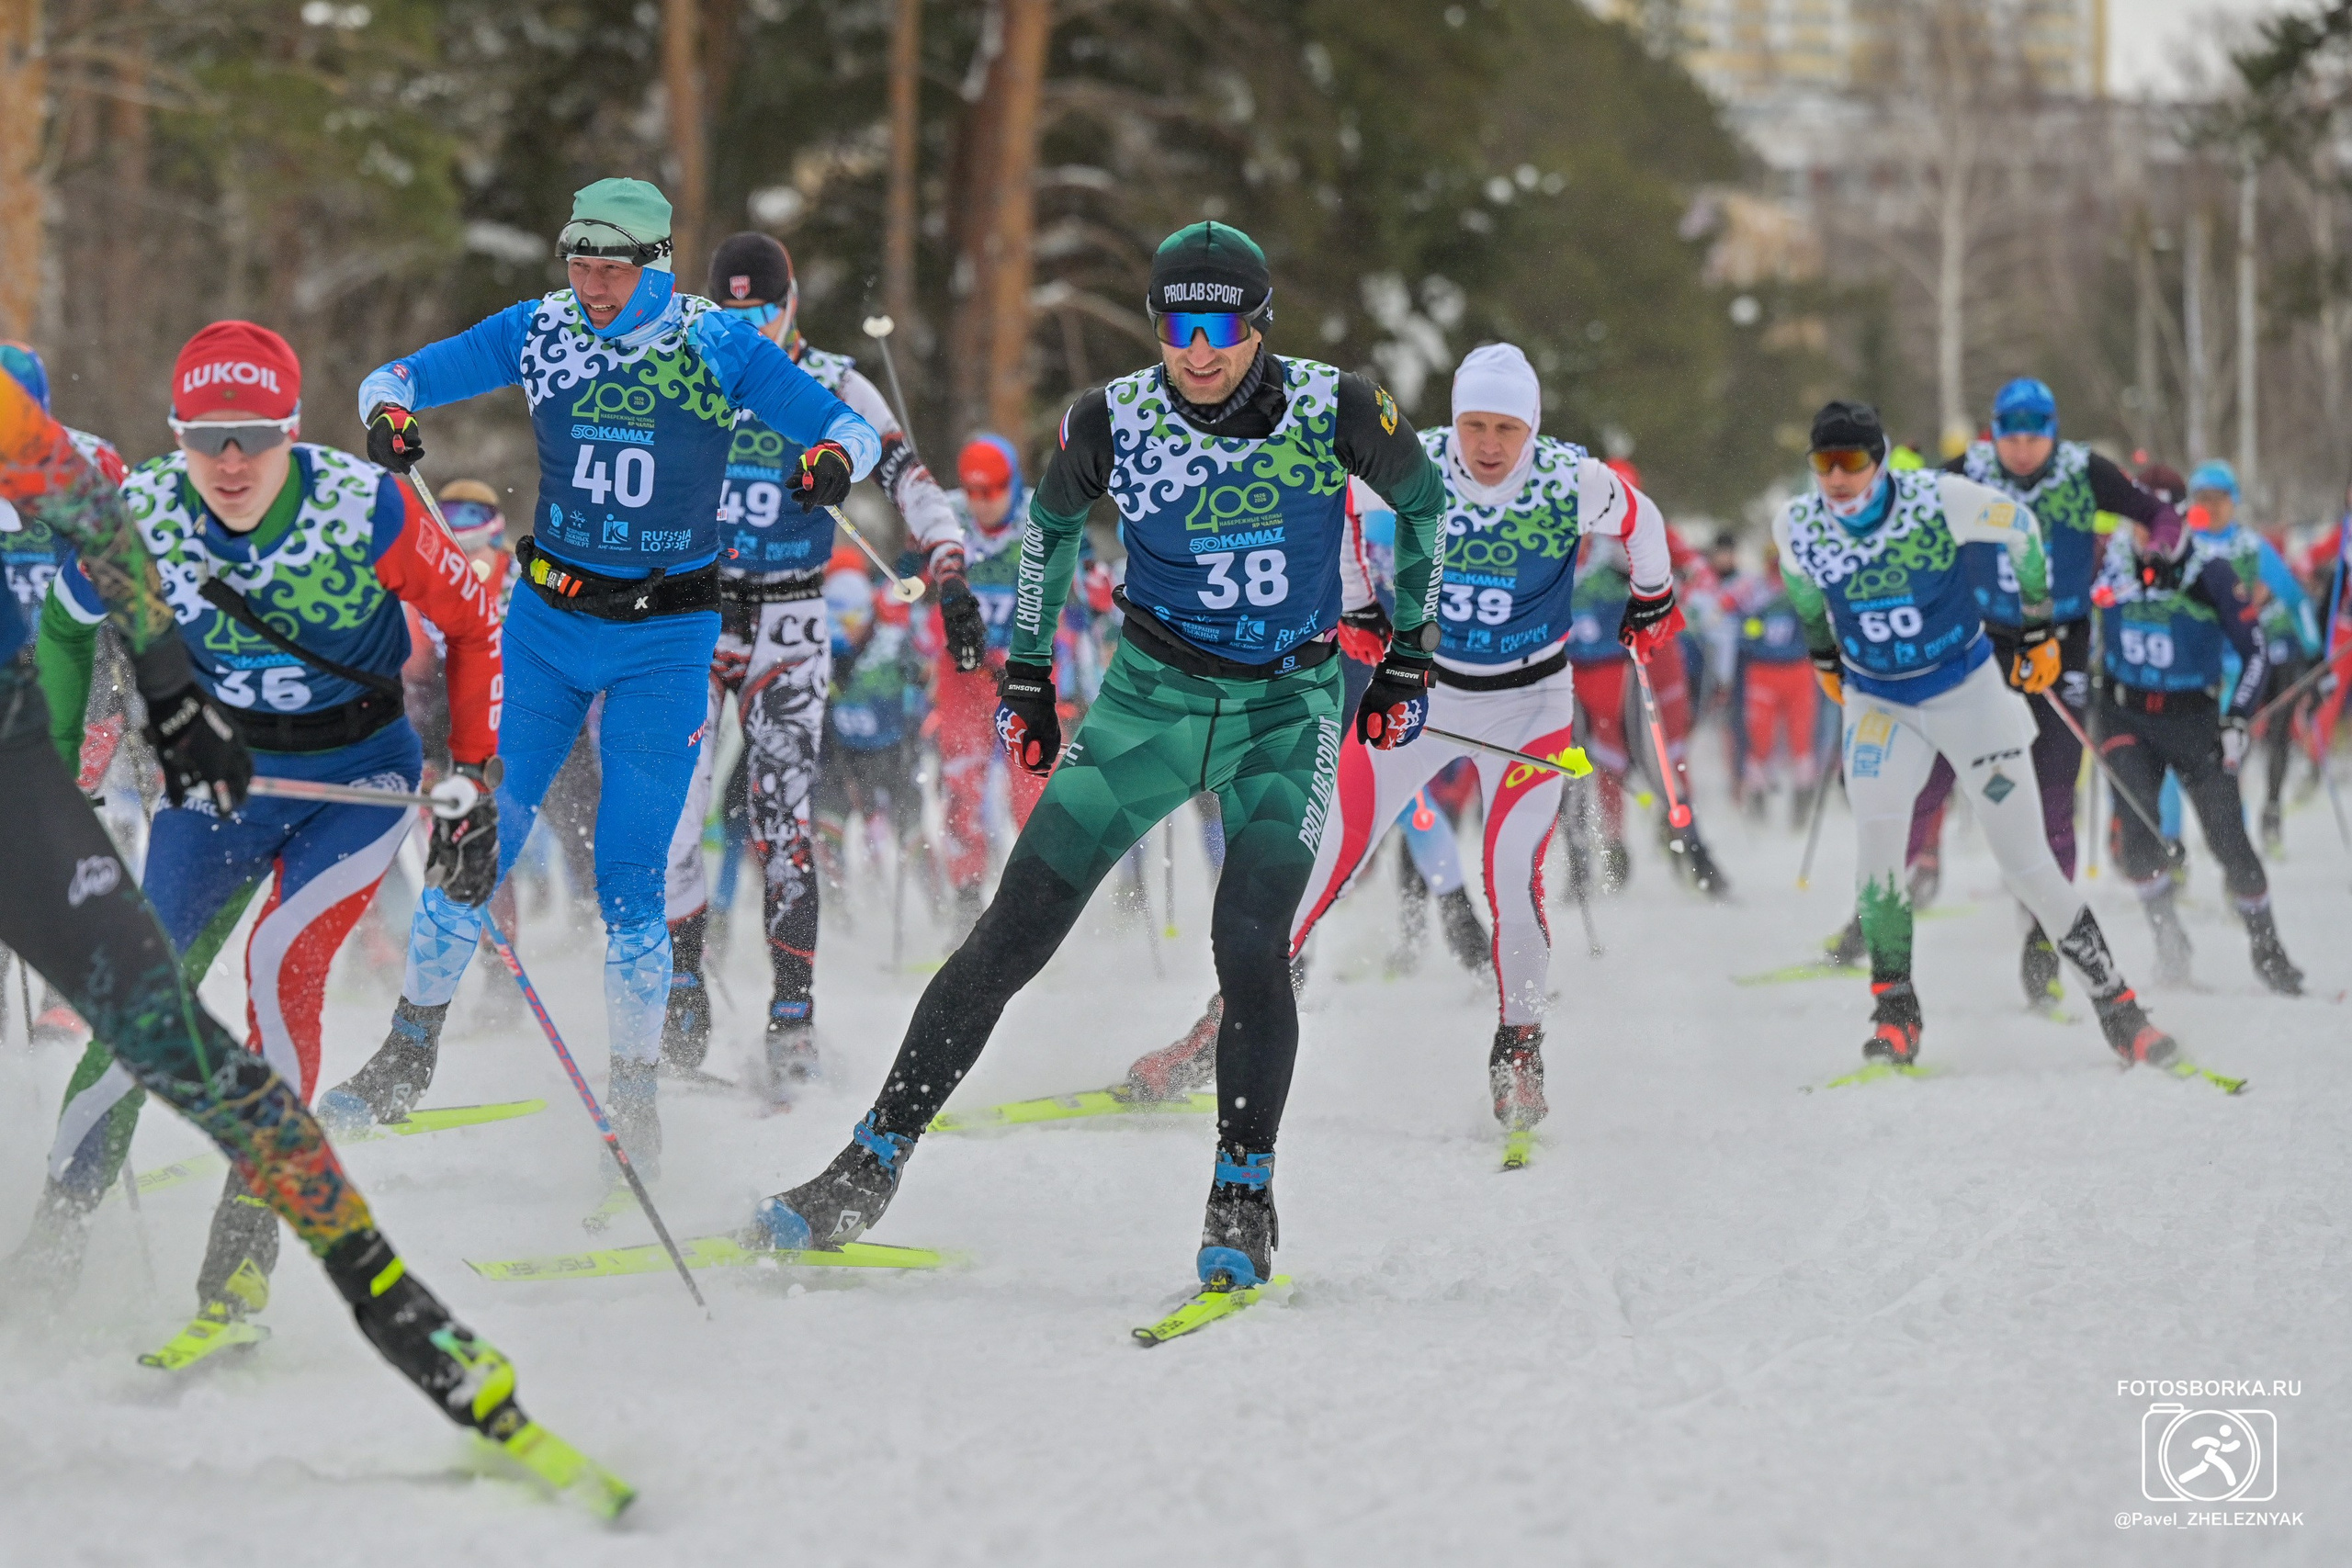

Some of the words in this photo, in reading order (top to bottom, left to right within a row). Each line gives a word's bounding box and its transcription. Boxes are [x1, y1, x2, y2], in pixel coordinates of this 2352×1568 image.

[1163, 282, 1205, 304] PROLAB
[1205, 282, 1244, 306] SPORT
[183, 361, 281, 395] LUKOIL
[571, 445, 655, 508] 40
[719, 479, 781, 528] 49
[1219, 516, 1261, 527] НАБЕРЕЖНЫЕ
[1261, 513, 1283, 522] ЧЕЛНЫ
[1220, 526, 1285, 549] KAMAZ
[1261, 518, 1283, 526] ЧАЛЛЫ
[1195, 549, 1289, 609] 38
[1441, 583, 1513, 626] 39
[1182, 622, 1220, 635] ФЕДЕРАЦИЯ
[1182, 627, 1219, 640] ЛЫЖНЫХ
[1859, 606, 1924, 643] 60
[2120, 628, 2175, 669] 59
[212, 664, 312, 711] 36
[1008, 683, 1042, 693] MADSHUS
[1385, 668, 1419, 680] MADSHUS
[1298, 771, 1332, 858] PROLAB
